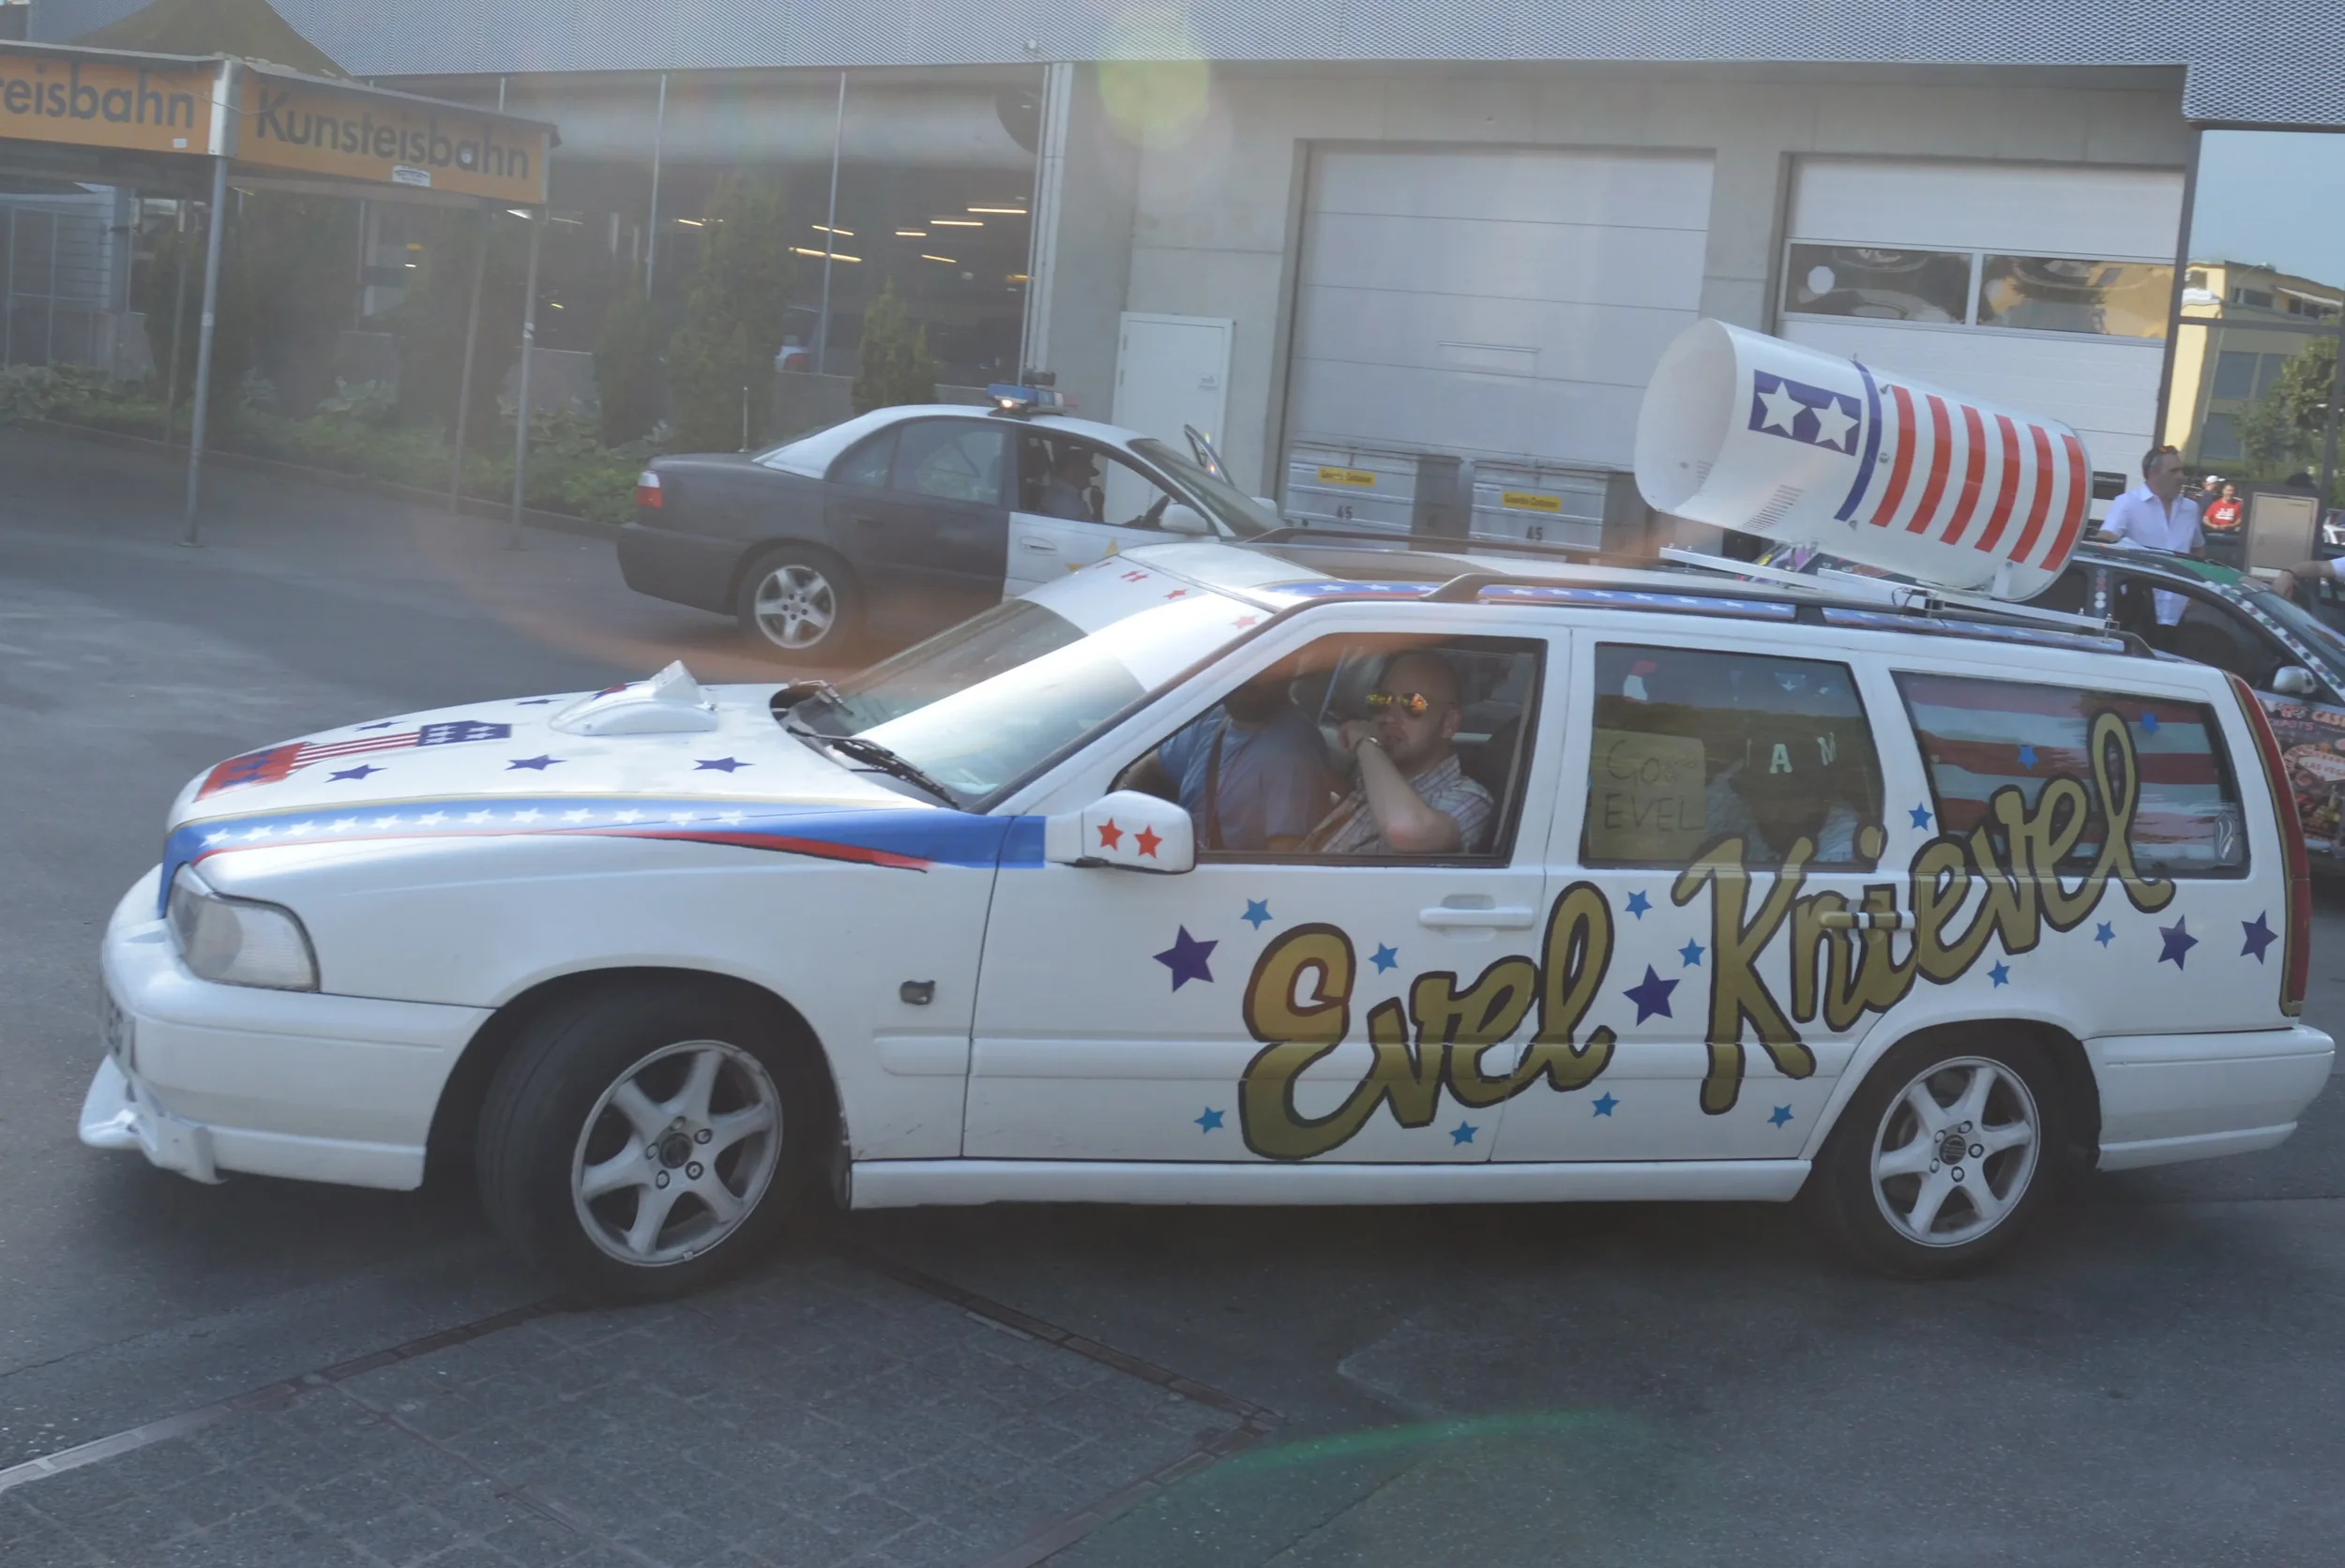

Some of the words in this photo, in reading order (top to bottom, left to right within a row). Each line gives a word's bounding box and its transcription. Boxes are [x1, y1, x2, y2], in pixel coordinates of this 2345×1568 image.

[0, 61, 194, 128] eisbahn
[256, 87, 529, 180] Kunsteisbahn
[1336, 505, 1354, 520] 45
[1525, 525, 1543, 540] 45
[1604, 792, 1705, 832] EVEL
[1239, 880, 1616, 1161] Evel
[1672, 713, 2175, 1116] Knievel
